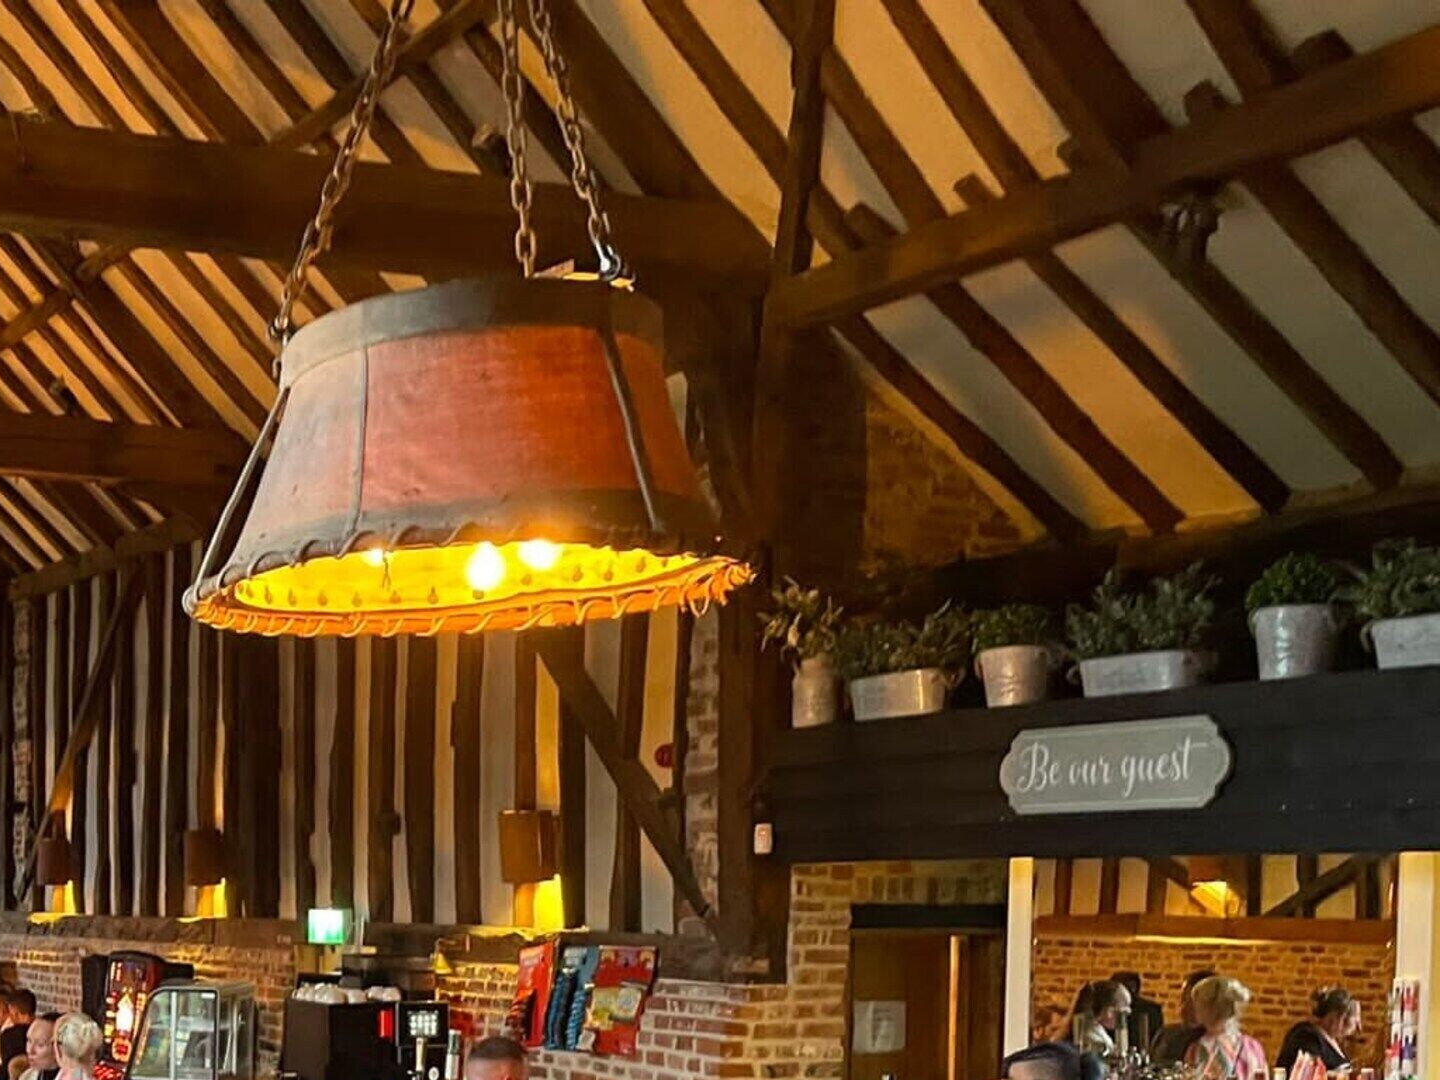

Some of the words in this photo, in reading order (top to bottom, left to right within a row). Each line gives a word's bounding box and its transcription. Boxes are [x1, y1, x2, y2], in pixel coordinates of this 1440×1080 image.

[1017, 740, 1061, 793] Be
[1070, 757, 1111, 787] our
[1121, 737, 1208, 798] guest
